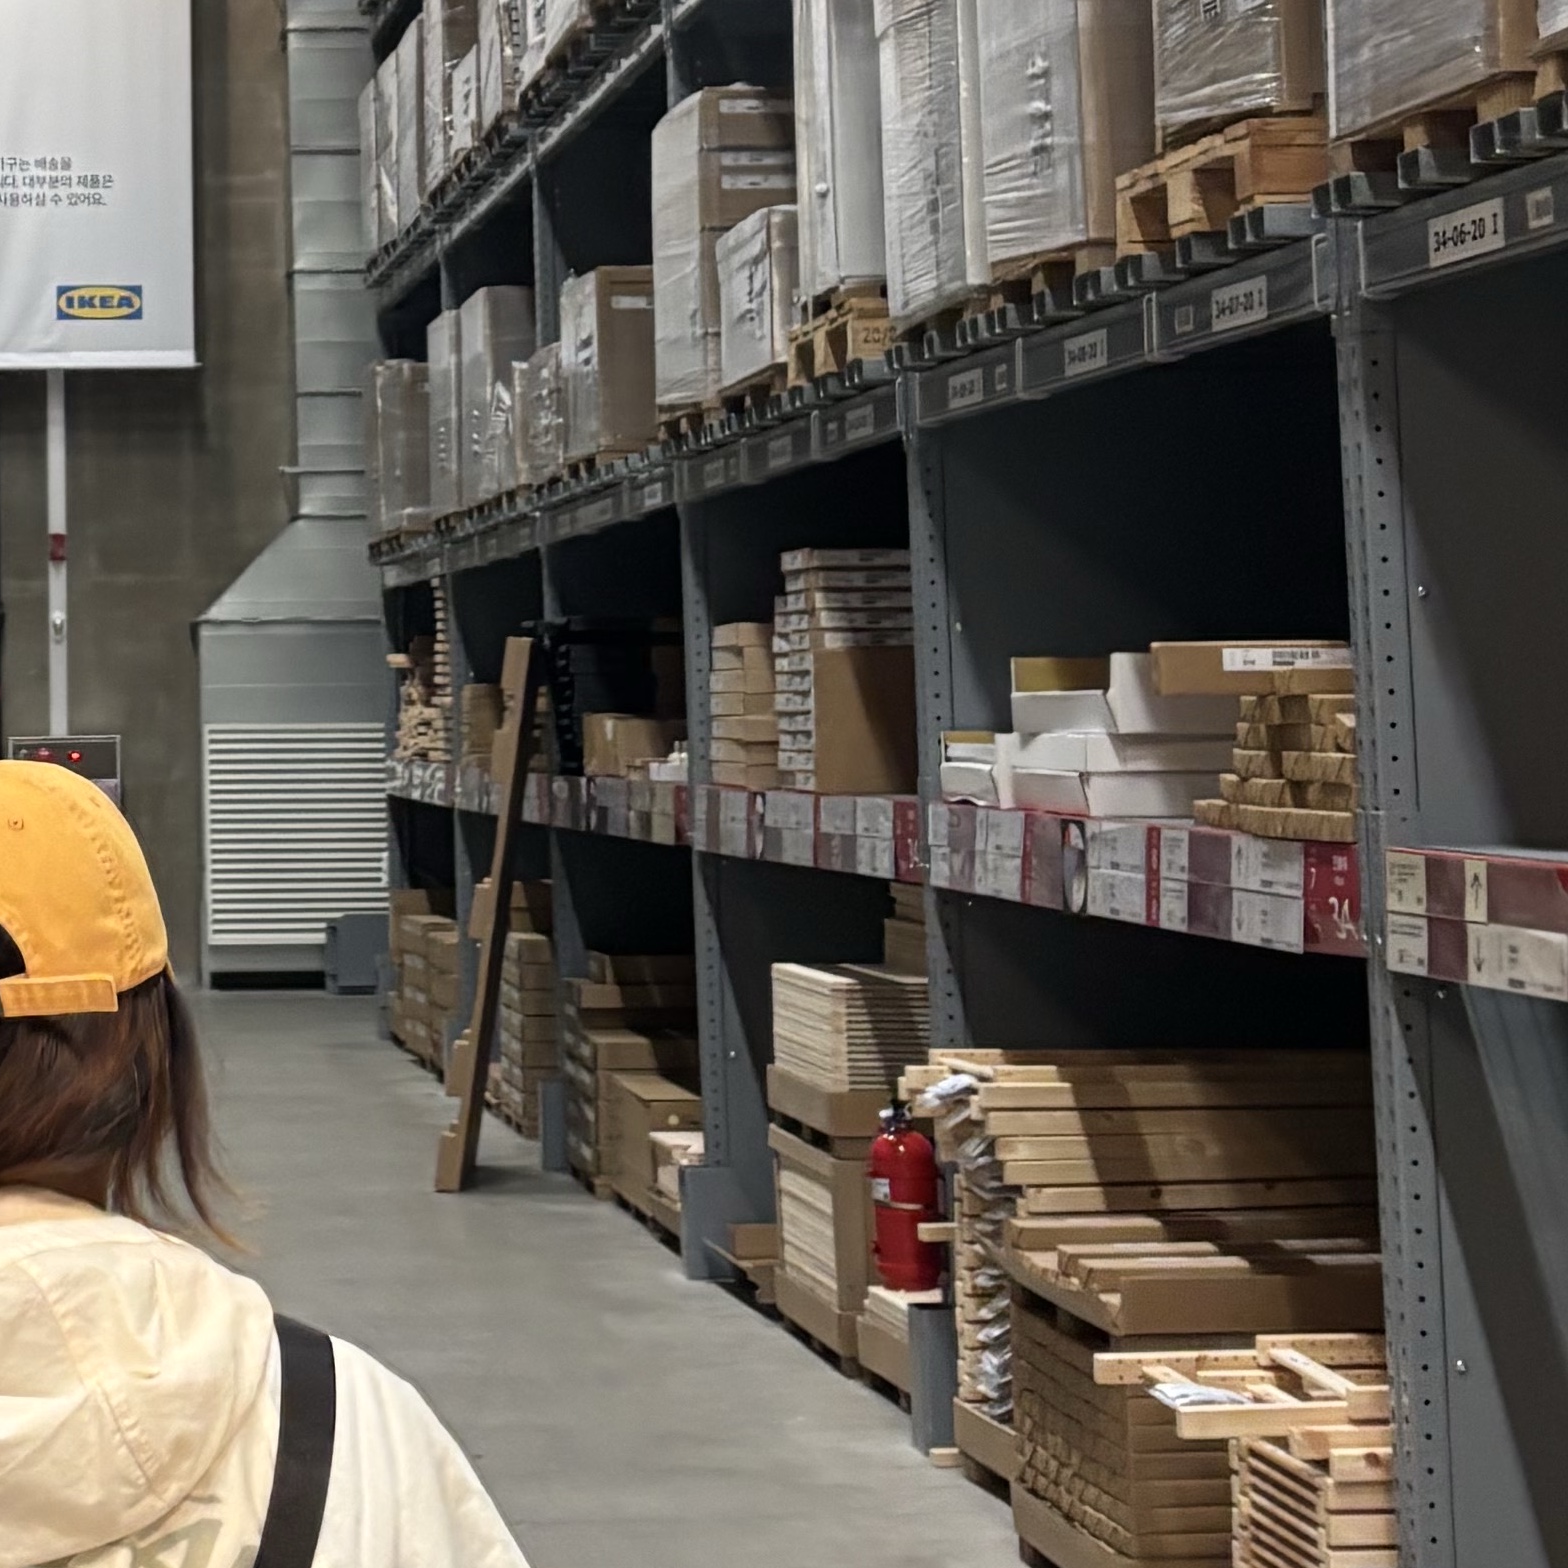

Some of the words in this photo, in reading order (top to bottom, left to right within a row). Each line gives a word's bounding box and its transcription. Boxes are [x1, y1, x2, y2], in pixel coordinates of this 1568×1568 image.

[22, 175, 72, 189] 대부분의
[50, 192, 63, 206] 수
[1433, 217, 1486, 253] 34-06-20
[65, 295, 135, 309] IKEA
